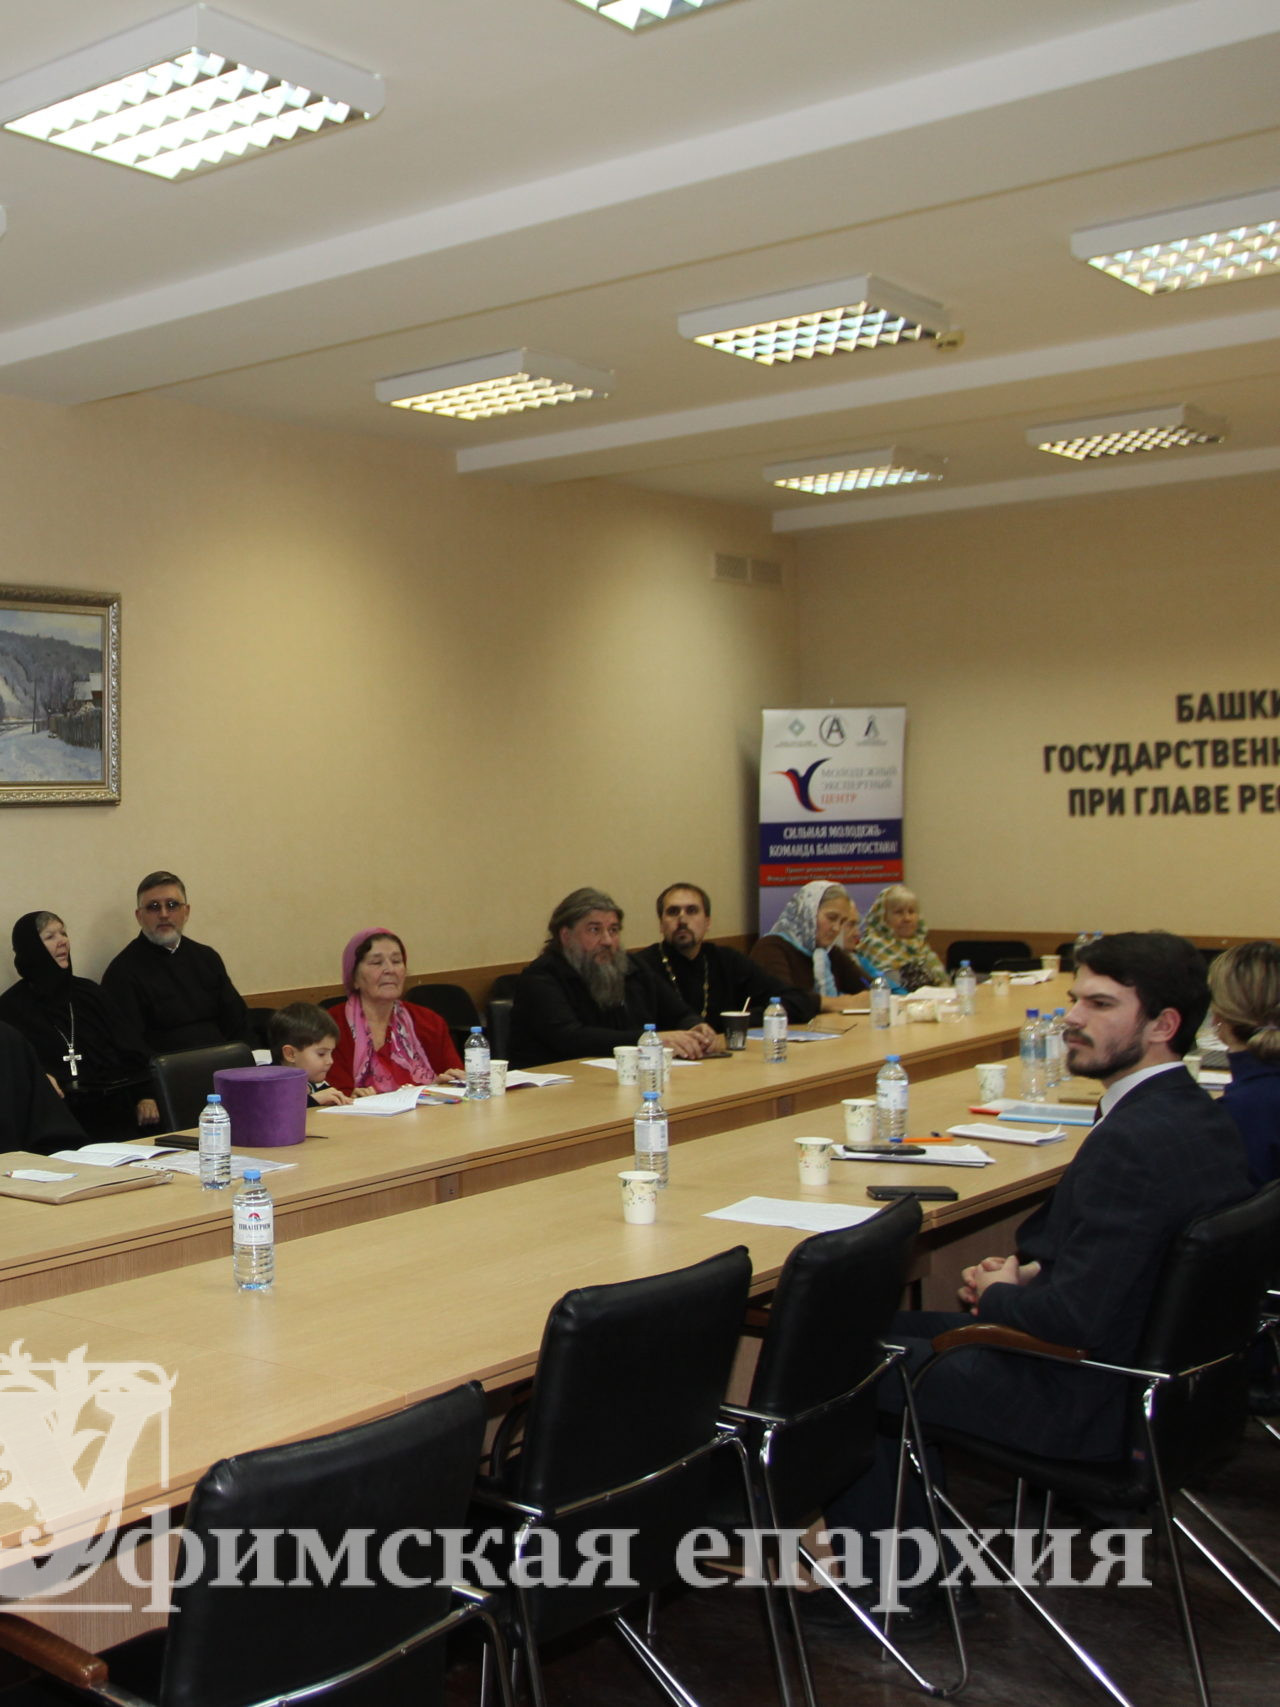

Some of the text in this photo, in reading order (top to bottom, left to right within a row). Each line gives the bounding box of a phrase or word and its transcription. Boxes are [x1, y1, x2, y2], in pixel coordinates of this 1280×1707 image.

[1069, 784, 1280, 816] ПРИ ГЛАВЕ РЕ
[783, 826, 827, 839] СИЛЬНАЯ
[769, 844, 815, 857] КОМАНДА
